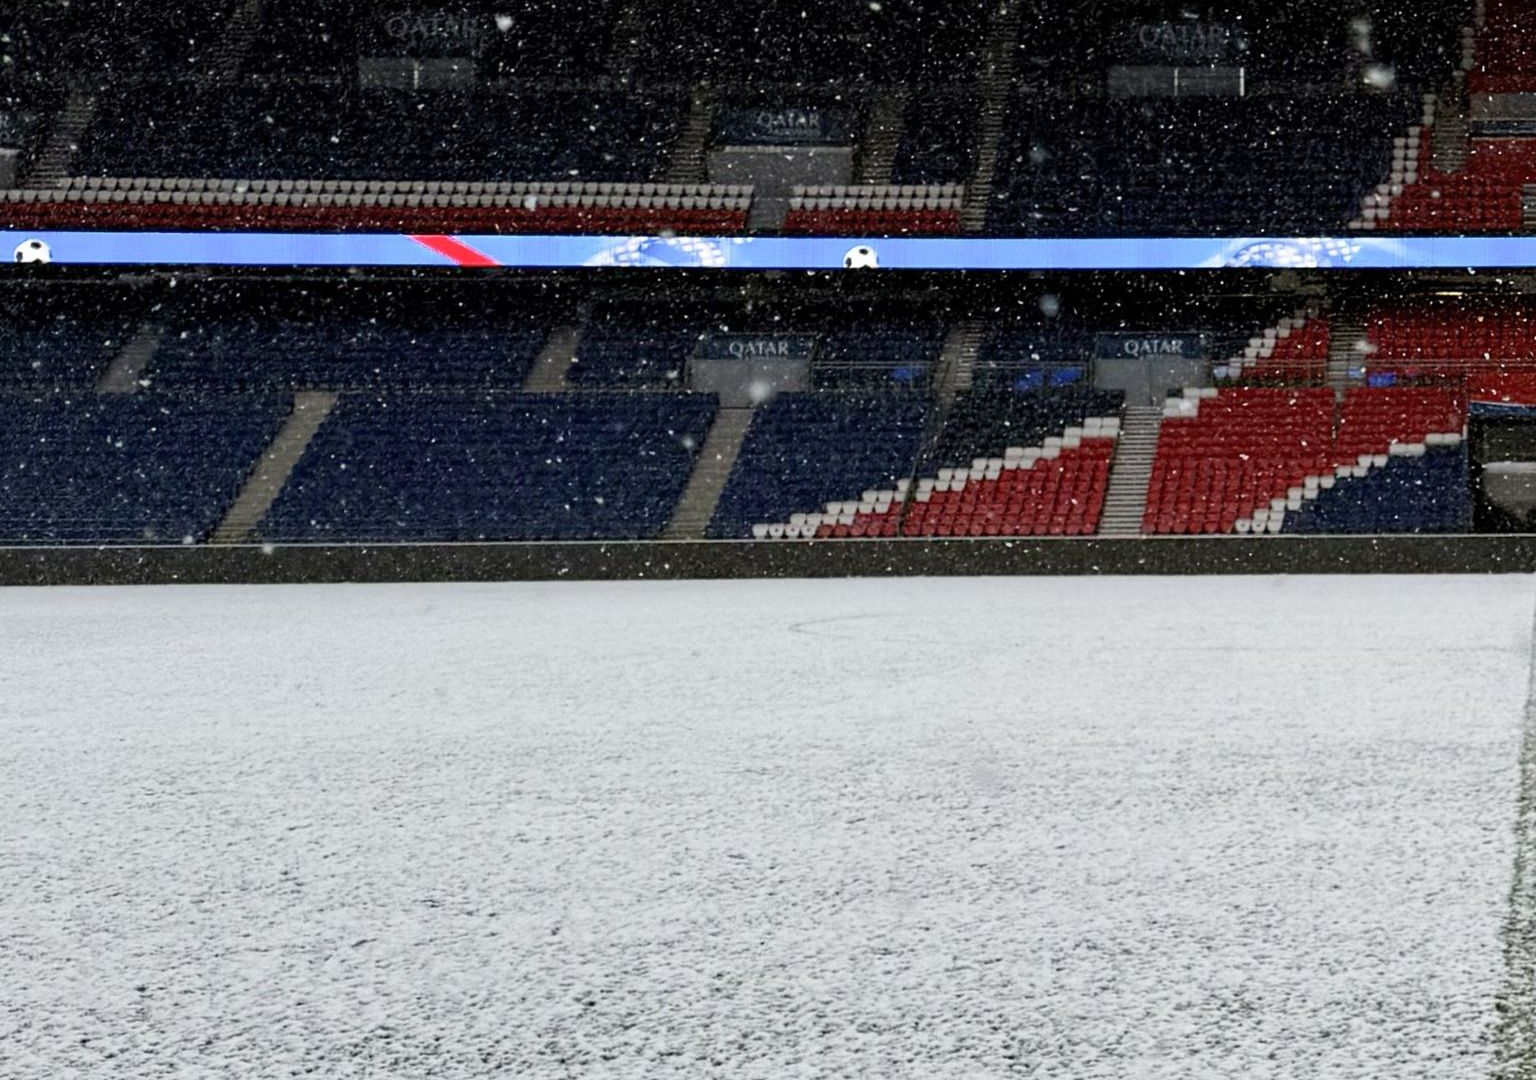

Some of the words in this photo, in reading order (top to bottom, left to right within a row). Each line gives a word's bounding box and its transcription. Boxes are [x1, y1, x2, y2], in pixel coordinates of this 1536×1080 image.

[756, 111, 820, 131] QATAR
[729, 341, 788, 358] QATAR
[1124, 339, 1184, 356] QATAR
